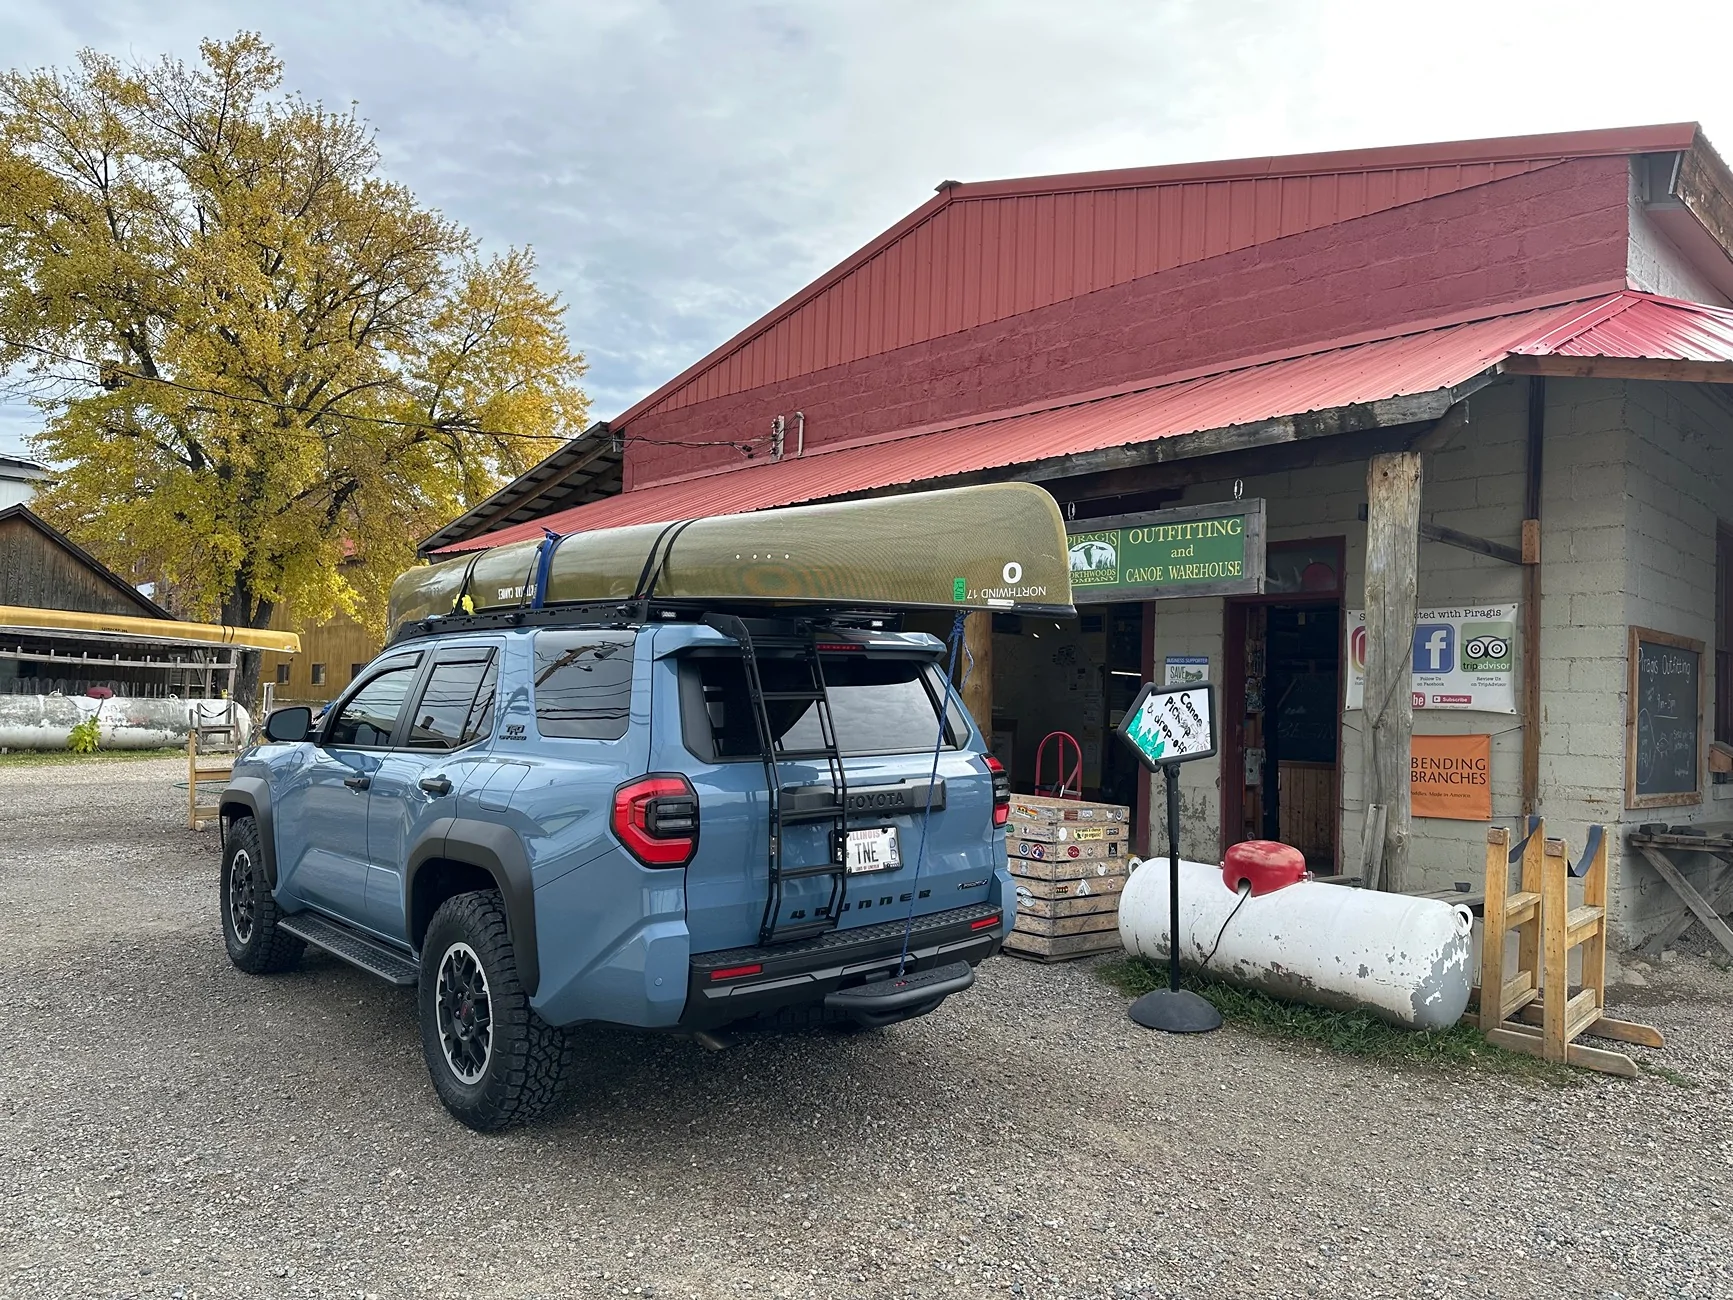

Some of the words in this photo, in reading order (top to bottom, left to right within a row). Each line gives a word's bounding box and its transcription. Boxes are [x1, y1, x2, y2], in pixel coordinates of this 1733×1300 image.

[1129, 518, 1242, 545] OUTFITTING
[1170, 544, 1194, 558] and
[1070, 568, 1116, 579] ORTHWOODS
[1126, 566, 1163, 583] CANOE
[1169, 561, 1242, 580] WAREHOUSE
[1071, 576, 1116, 584] OMPANY
[967, 589, 978, 600] 17
[981, 586, 1046, 599] NORTHWIND
[1438, 609, 1462, 619] with
[1463, 607, 1502, 619] Piragis
[1462, 660, 1511, 671] tripadvisor
[1170, 666, 1186, 679] SAVE
[1180, 692, 1203, 728] Canoe
[1411, 757, 1487, 771] BENDING
[1411, 771, 1487, 785] BRANCHES
[847, 792, 905, 809] TOYOTA
[849, 830, 881, 841] ILLINOIS
[855, 841, 879, 864] TNE
